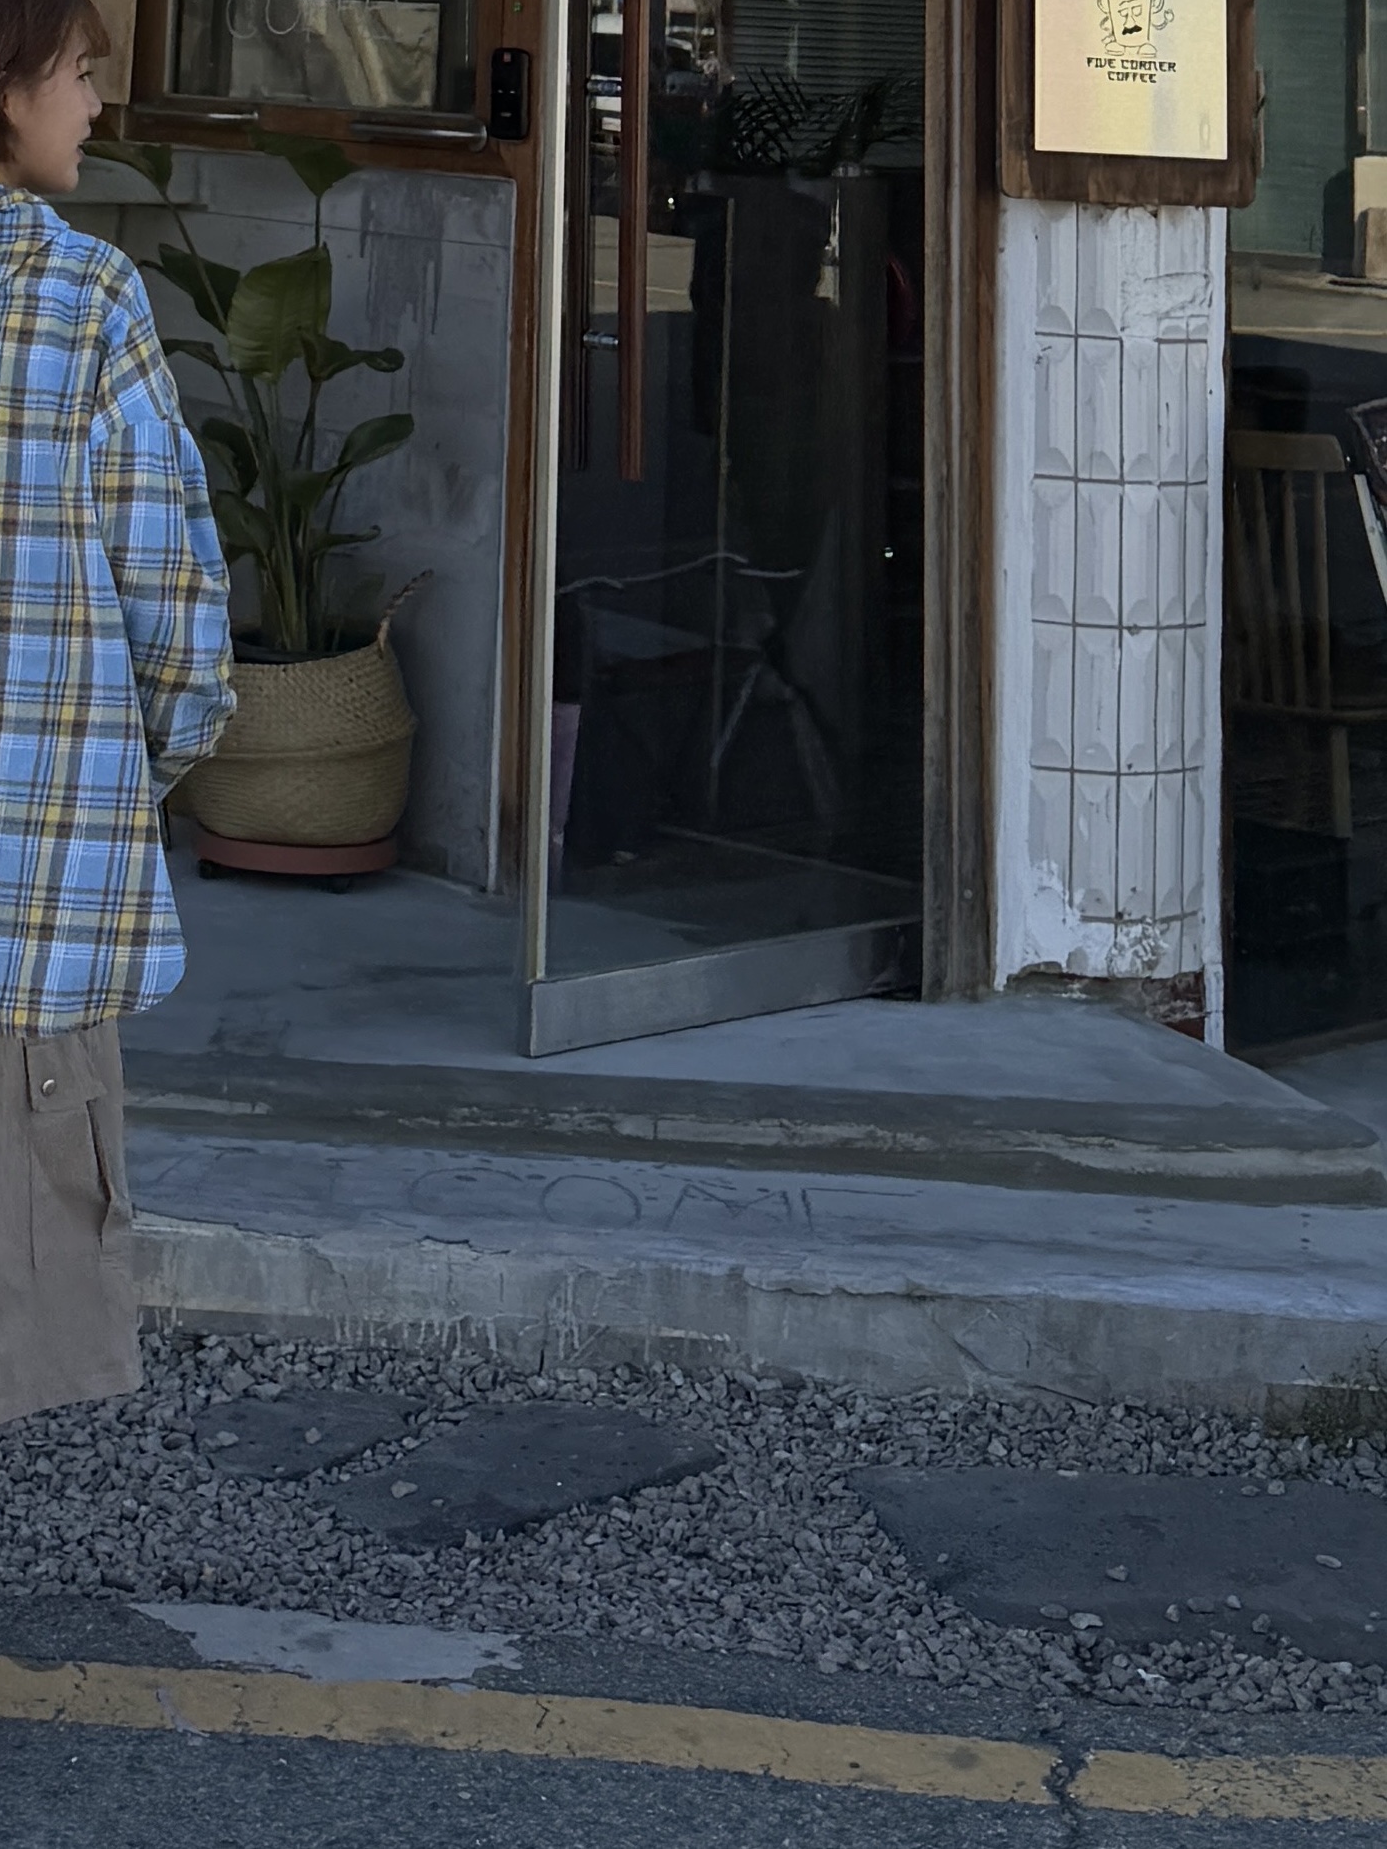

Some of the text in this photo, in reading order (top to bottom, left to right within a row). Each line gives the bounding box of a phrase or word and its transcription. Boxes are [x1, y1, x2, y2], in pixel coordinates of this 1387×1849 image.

[1086, 56, 1177, 72] FIVE CORNER
[1107, 70, 1157, 84] COFFEE
